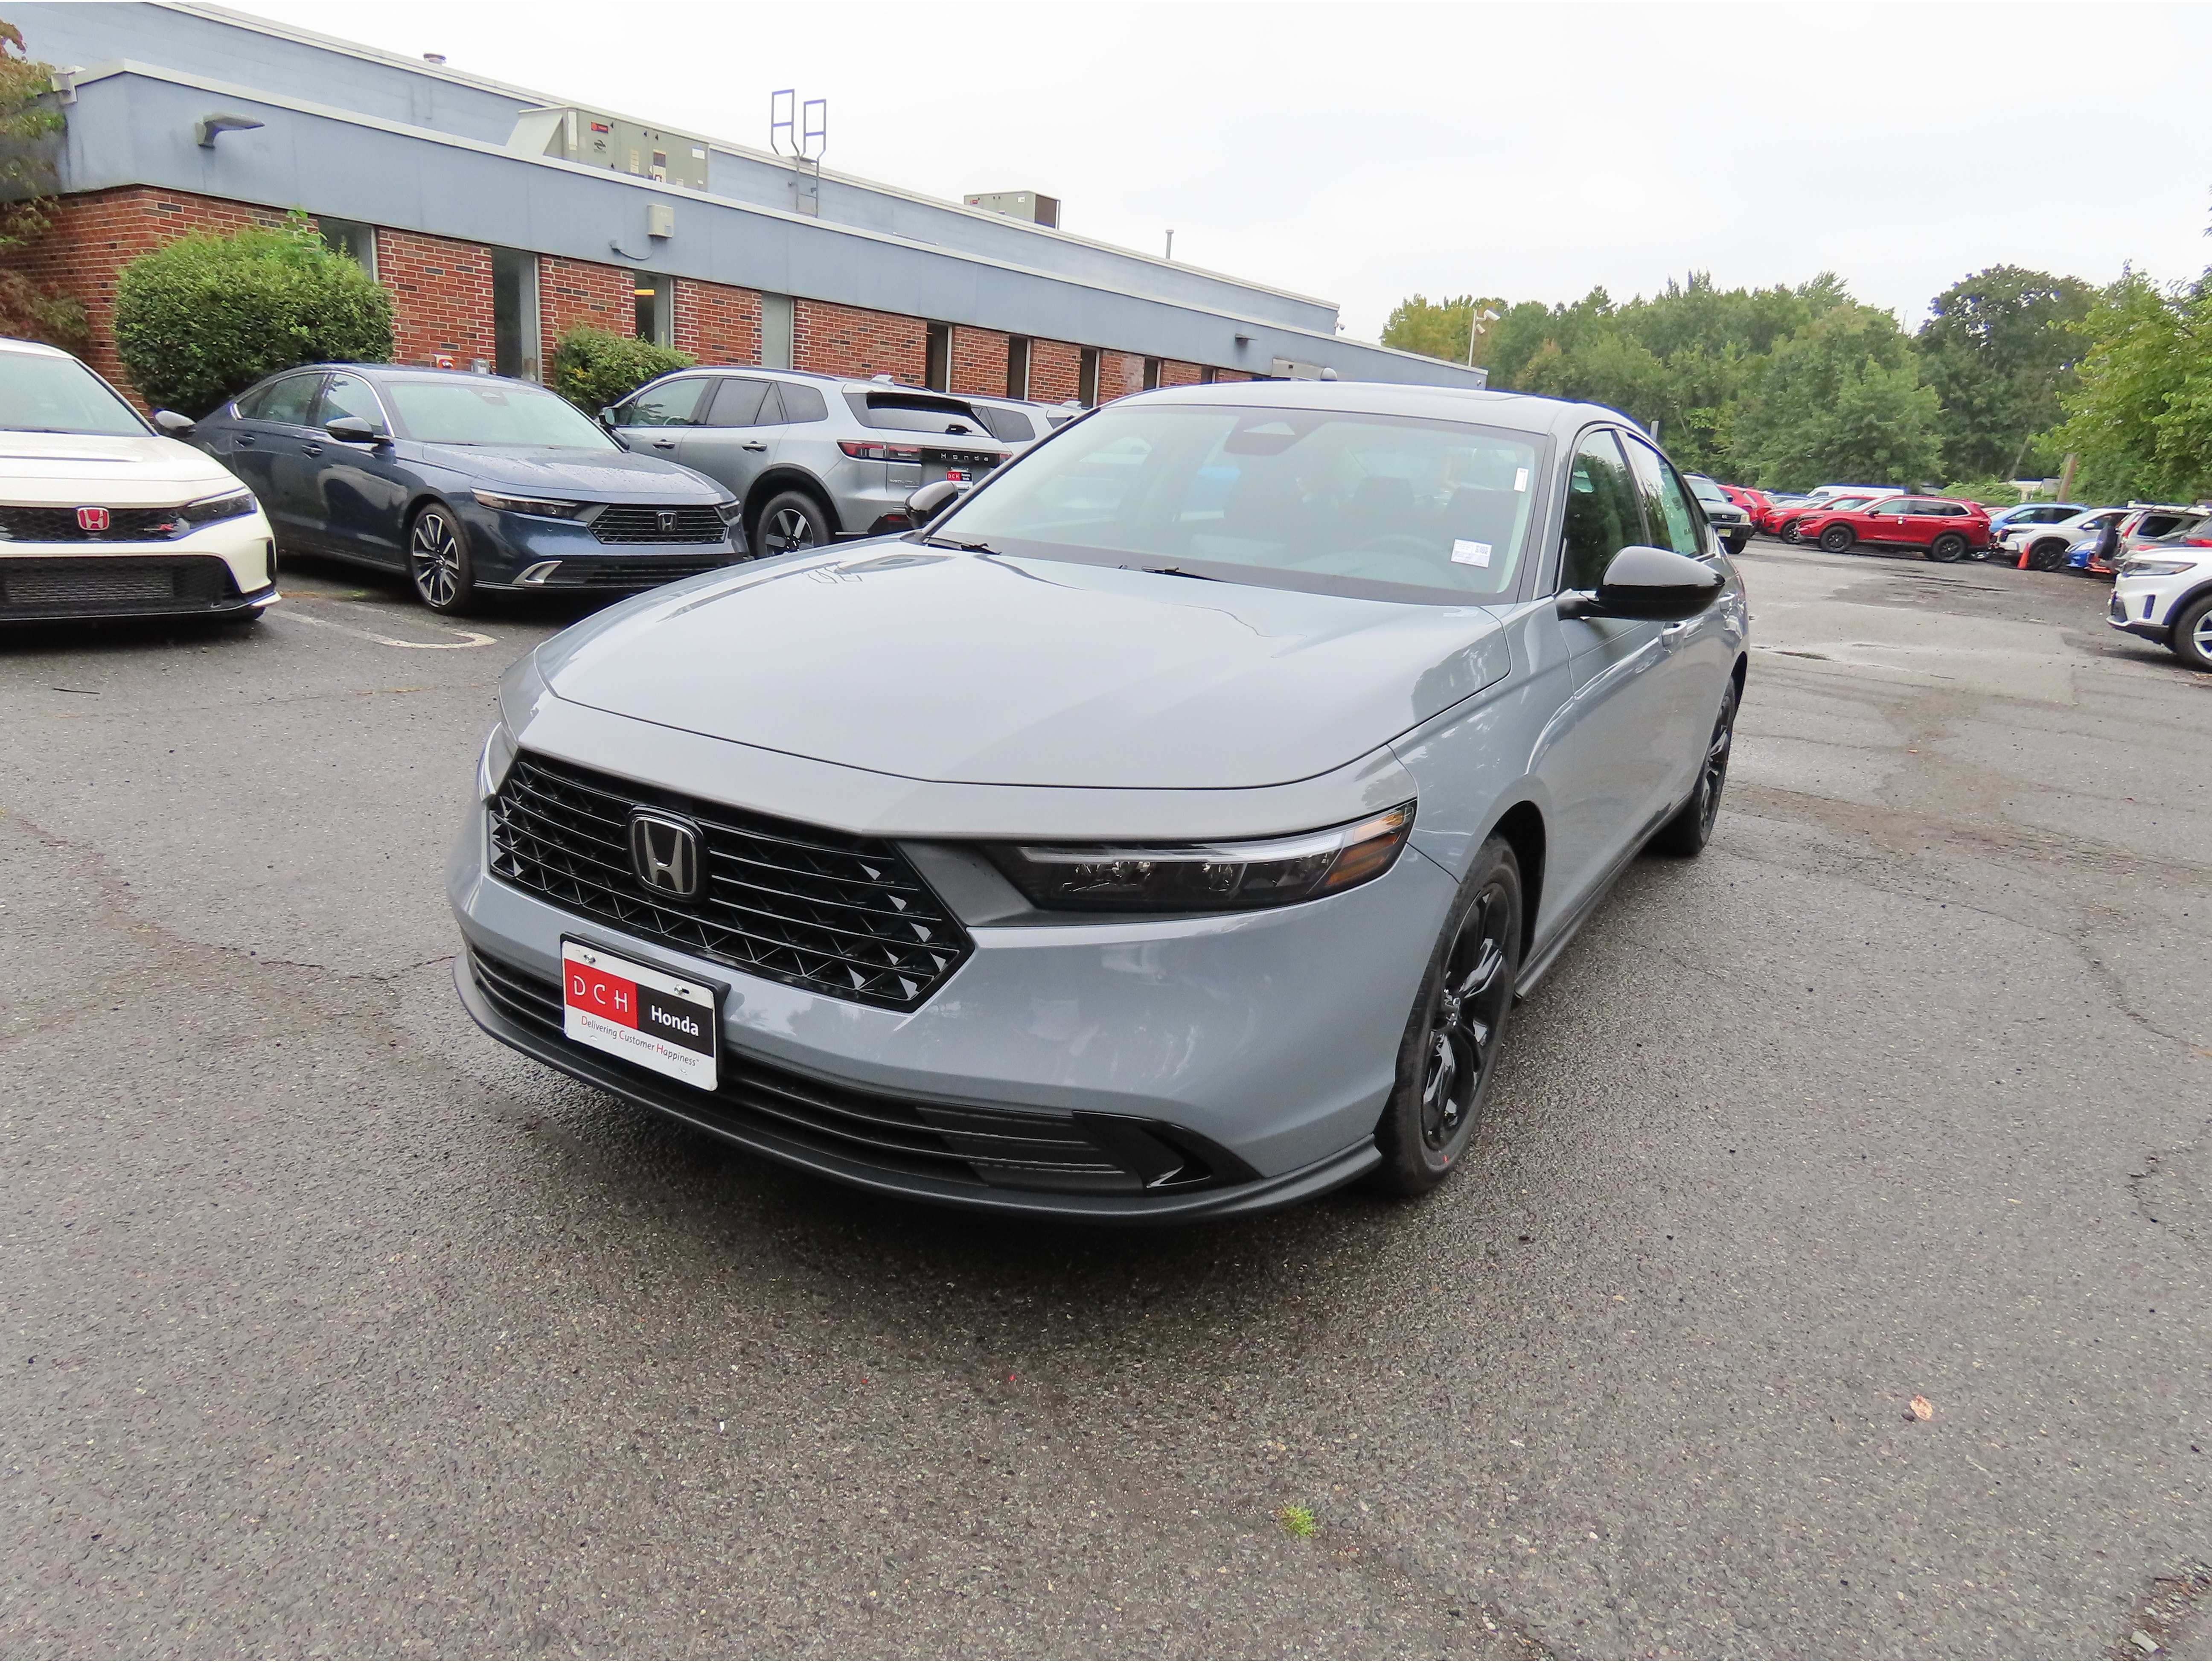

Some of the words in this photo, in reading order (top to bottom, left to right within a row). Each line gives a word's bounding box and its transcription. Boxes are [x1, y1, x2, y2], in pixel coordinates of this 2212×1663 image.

[581, 1015, 617, 1040] Delivering
[619, 1030, 655, 1051] Customer
[656, 1043, 696, 1067] Happiness
[651, 1005, 699, 1037] Honda
